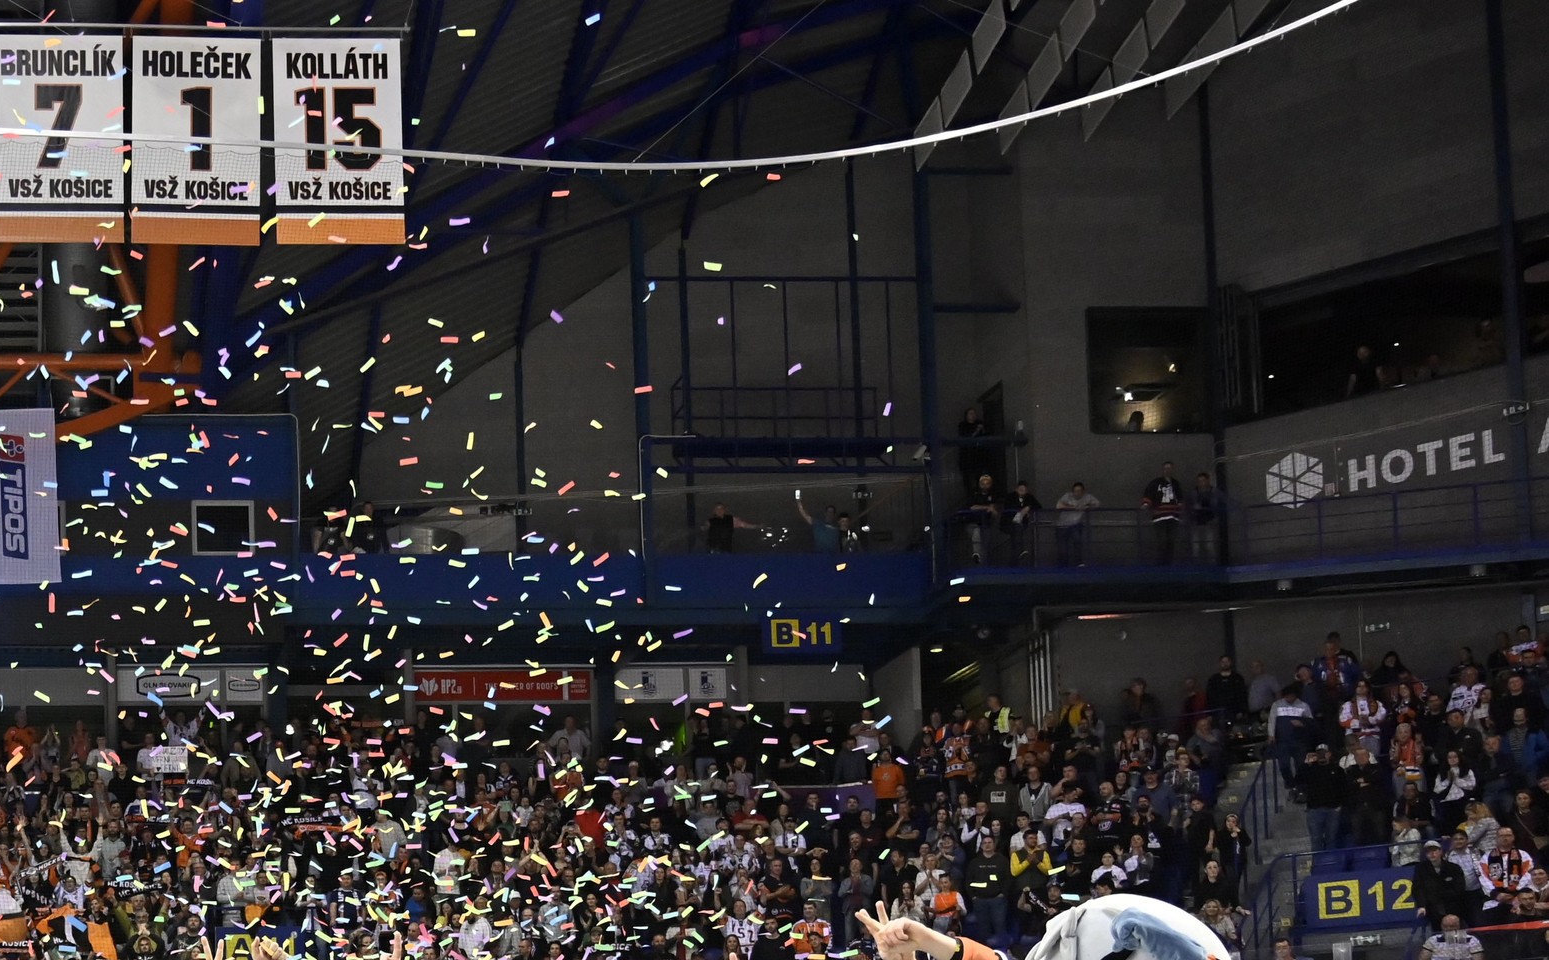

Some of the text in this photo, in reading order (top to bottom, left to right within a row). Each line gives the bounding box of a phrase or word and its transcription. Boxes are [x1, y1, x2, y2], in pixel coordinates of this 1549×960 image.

[1, 44, 116, 77] BRUNCLÍK
[142, 46, 251, 79] HOLEČEK
[286, 47, 388, 79] KOLLÁTH
[34, 84, 83, 169] 7
[180, 86, 212, 171] 1
[295, 86, 382, 171] 15
[9, 173, 112, 198] VSŽ KOŠICE
[144, 174, 248, 201] VSŽ KOŠICE
[288, 176, 392, 201] VSŽ KOŠICE
[1348, 429, 1505, 492] HOTEL
[3, 469, 25, 554] TIPOS
[777, 622, 832, 646] B 11
[1325, 879, 1415, 915] B 12
